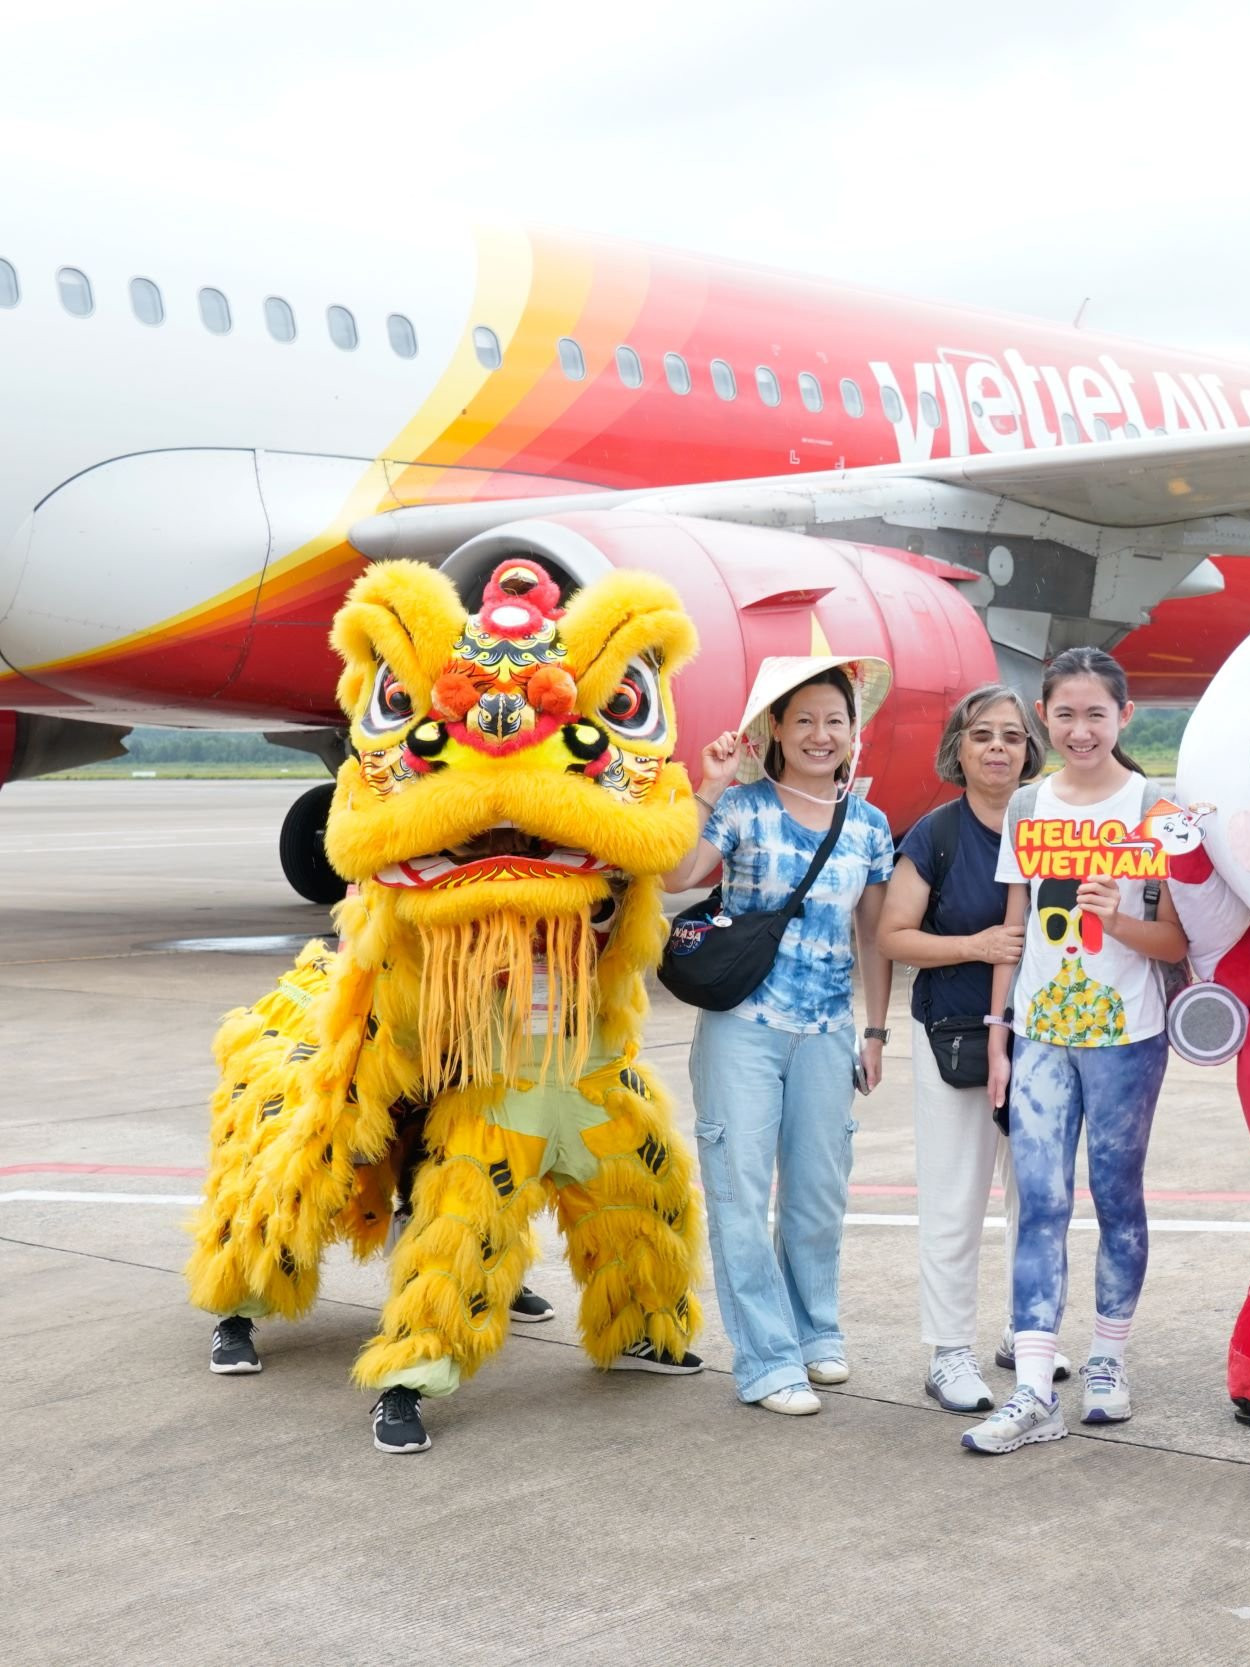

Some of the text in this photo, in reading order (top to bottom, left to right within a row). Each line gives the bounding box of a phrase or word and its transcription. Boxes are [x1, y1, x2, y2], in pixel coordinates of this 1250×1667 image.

[1018, 821, 1126, 848] HELLO
[1018, 850, 1167, 877] VIETNAM
[672, 927, 702, 942] NASA
